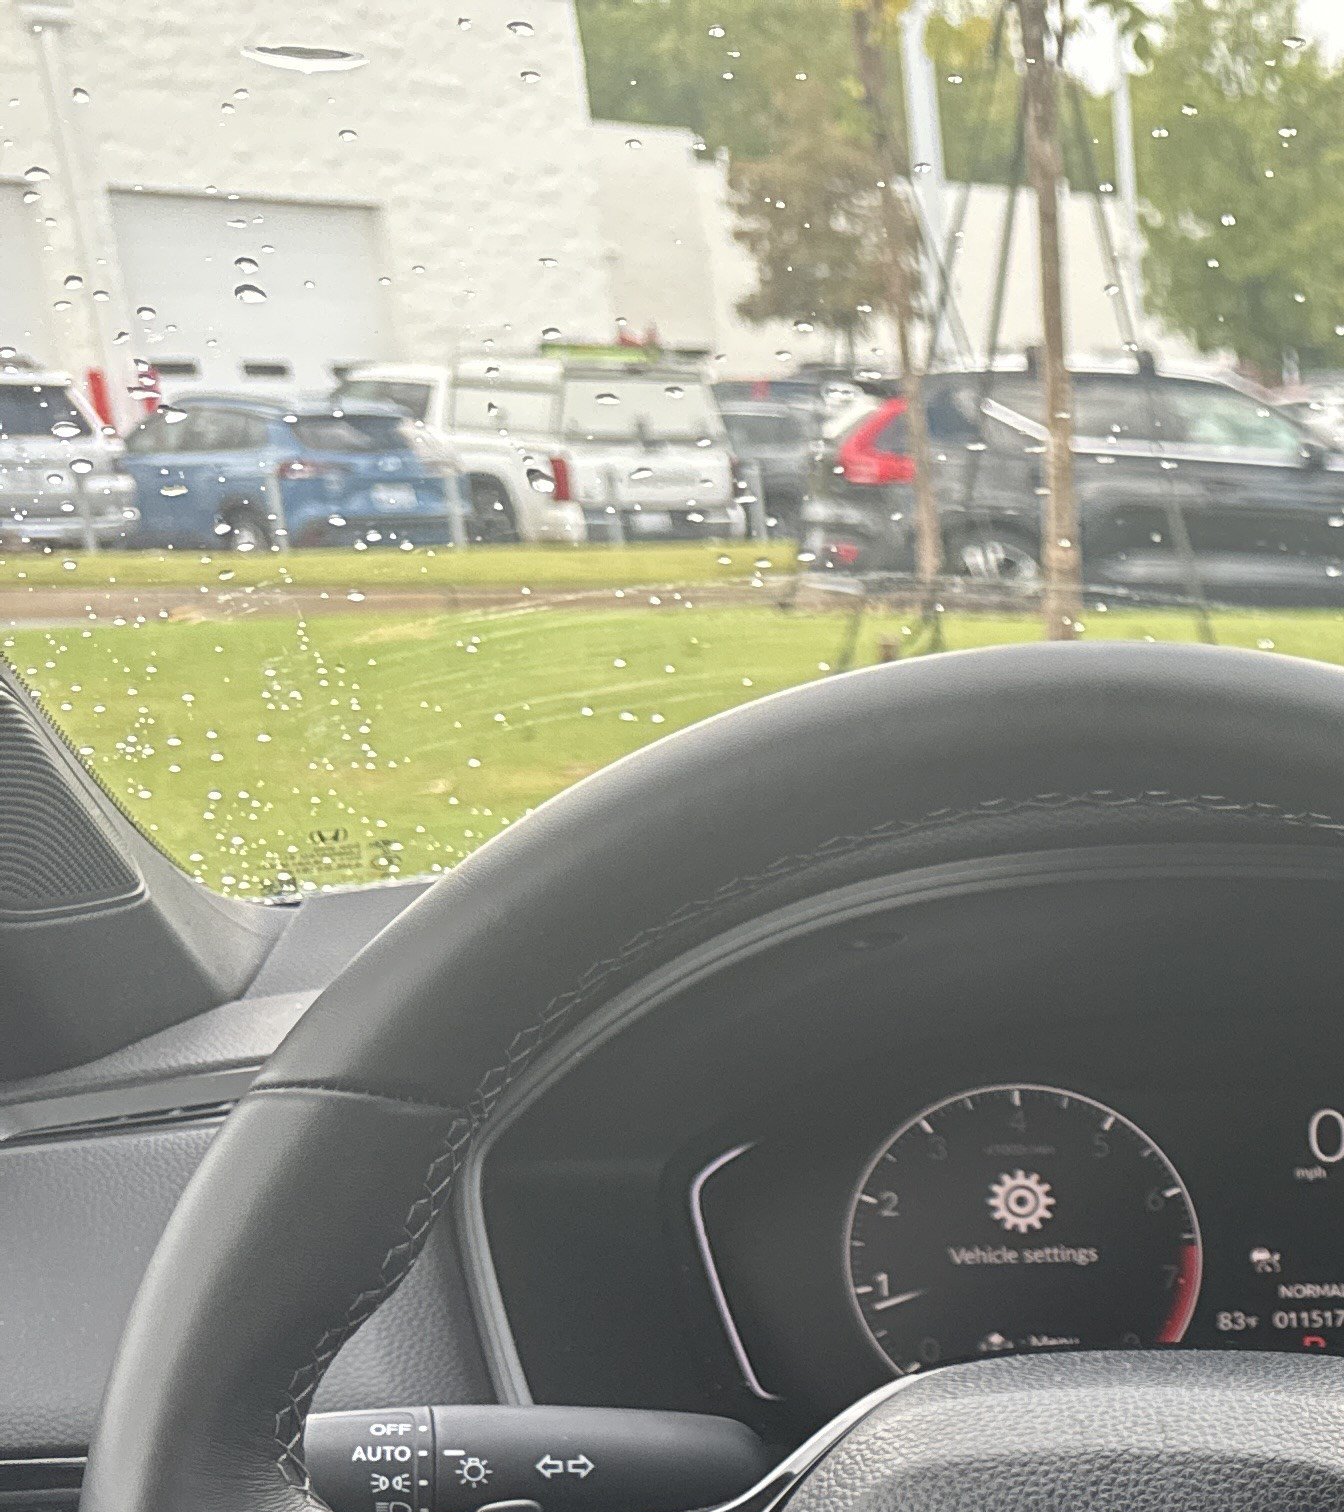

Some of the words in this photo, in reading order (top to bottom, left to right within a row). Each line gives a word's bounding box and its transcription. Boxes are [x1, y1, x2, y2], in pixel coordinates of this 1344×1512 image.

[1295, 1167, 1327, 1181] mph
[881, 1191, 899, 1217] 2
[948, 1246, 1019, 1265] Vehicle
[1024, 1243, 1099, 1265] settings
[876, 1273, 889, 1297] 1
[370, 1423, 411, 1436] OFF
[351, 1445, 412, 1462] AUTO
